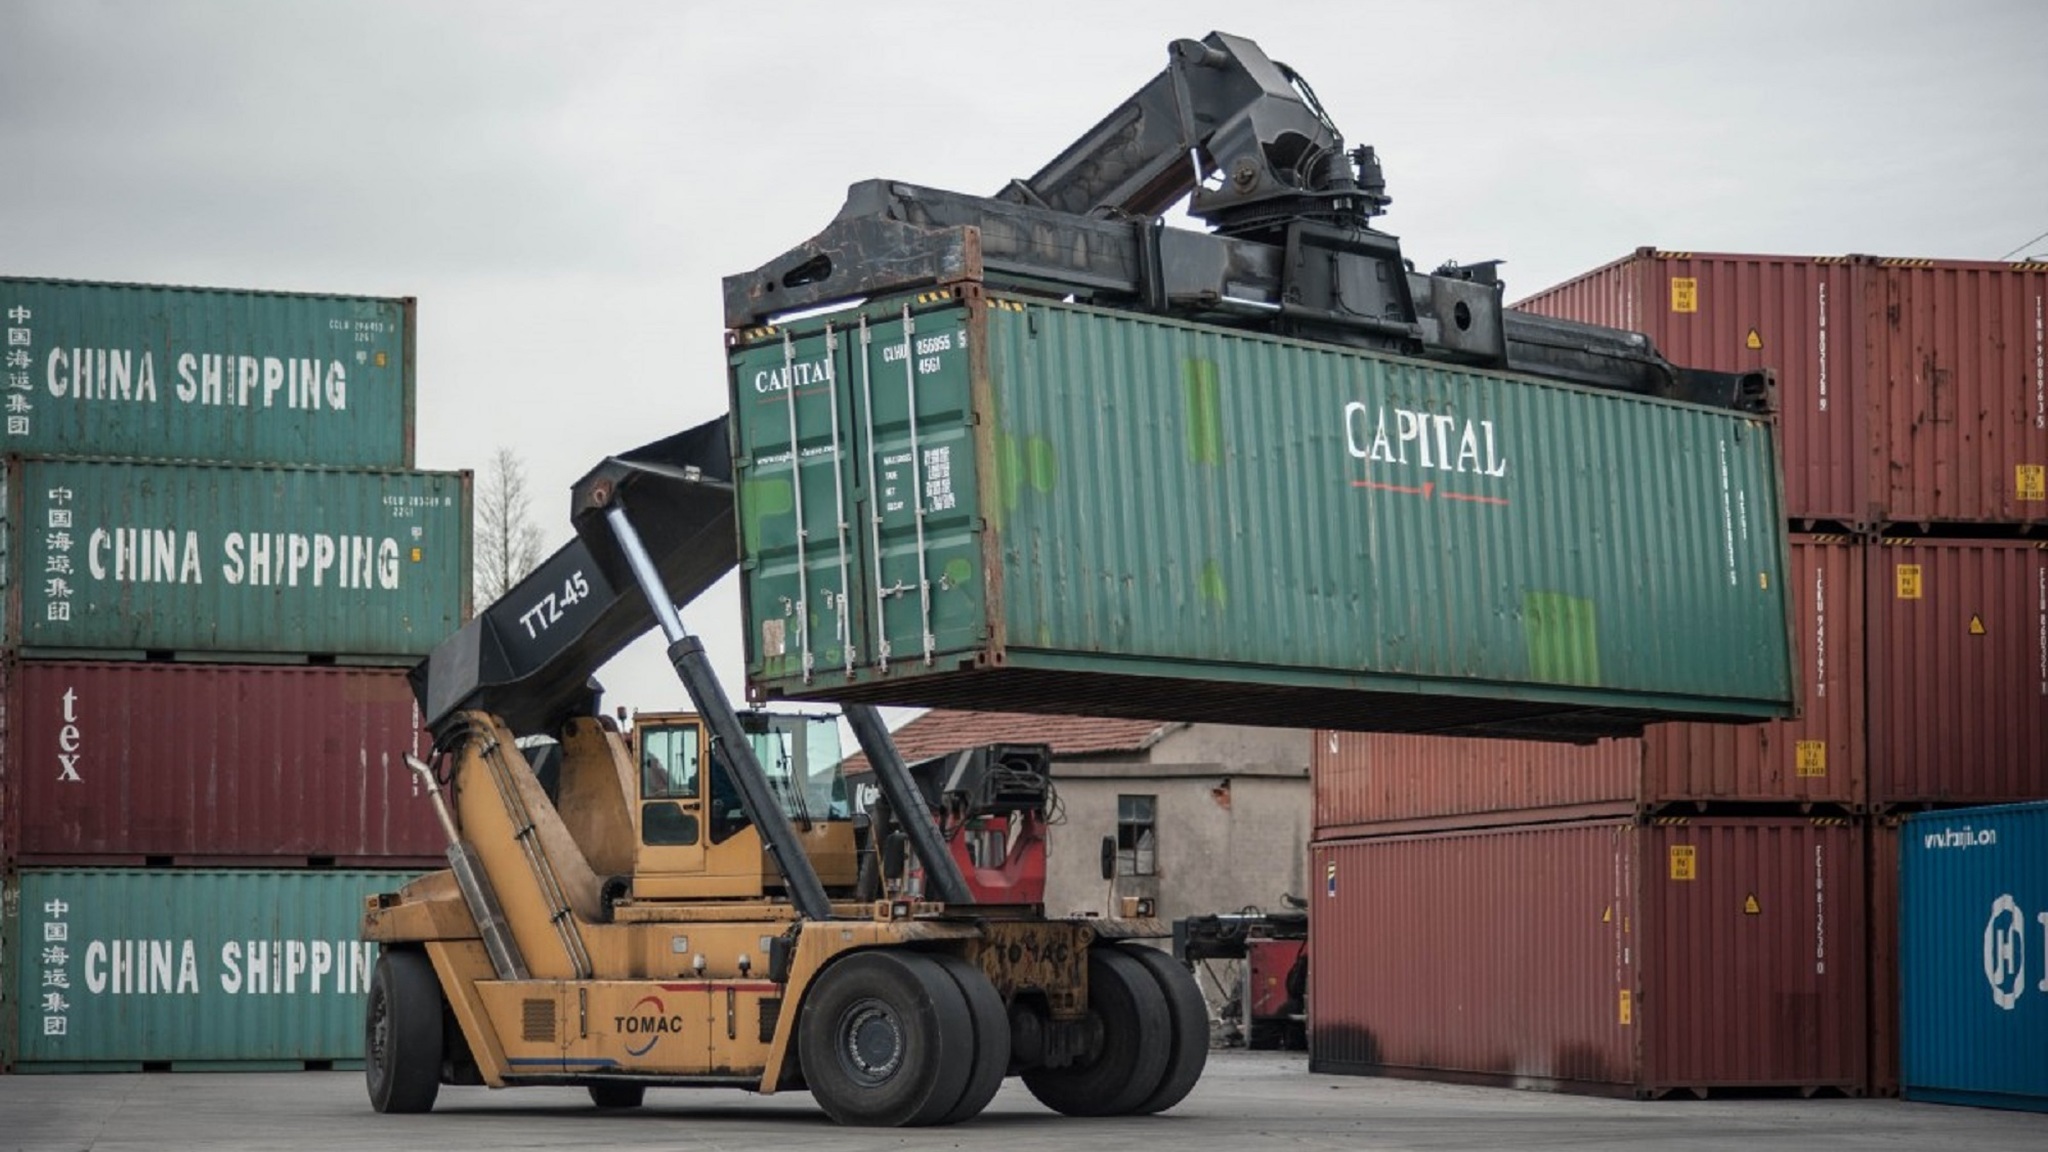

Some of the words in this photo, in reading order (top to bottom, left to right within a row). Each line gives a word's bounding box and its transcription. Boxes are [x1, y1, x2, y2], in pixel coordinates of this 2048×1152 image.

[7, 305, 33, 436] 中国海运集团
[957, 328, 967, 349] 5
[46, 346, 157, 402] CHINA
[176, 353, 347, 411] SHIPPING
[1345, 402, 1507, 478] CAPITAL
[2036, 415, 2045, 428] 5
[45, 487, 74, 621] 中国海运集团
[89, 527, 203, 584] CHINA
[222, 532, 400, 590] SHIPPING
[519, 570, 590, 640] TTZ-45
[57, 687, 83, 782] tex
[42, 898, 70, 1035] 中国海运集团
[85, 939, 199, 994] CHINA
[220, 939, 381, 994] SHIPPIN
[614, 1015, 683, 1034] TOMAC
